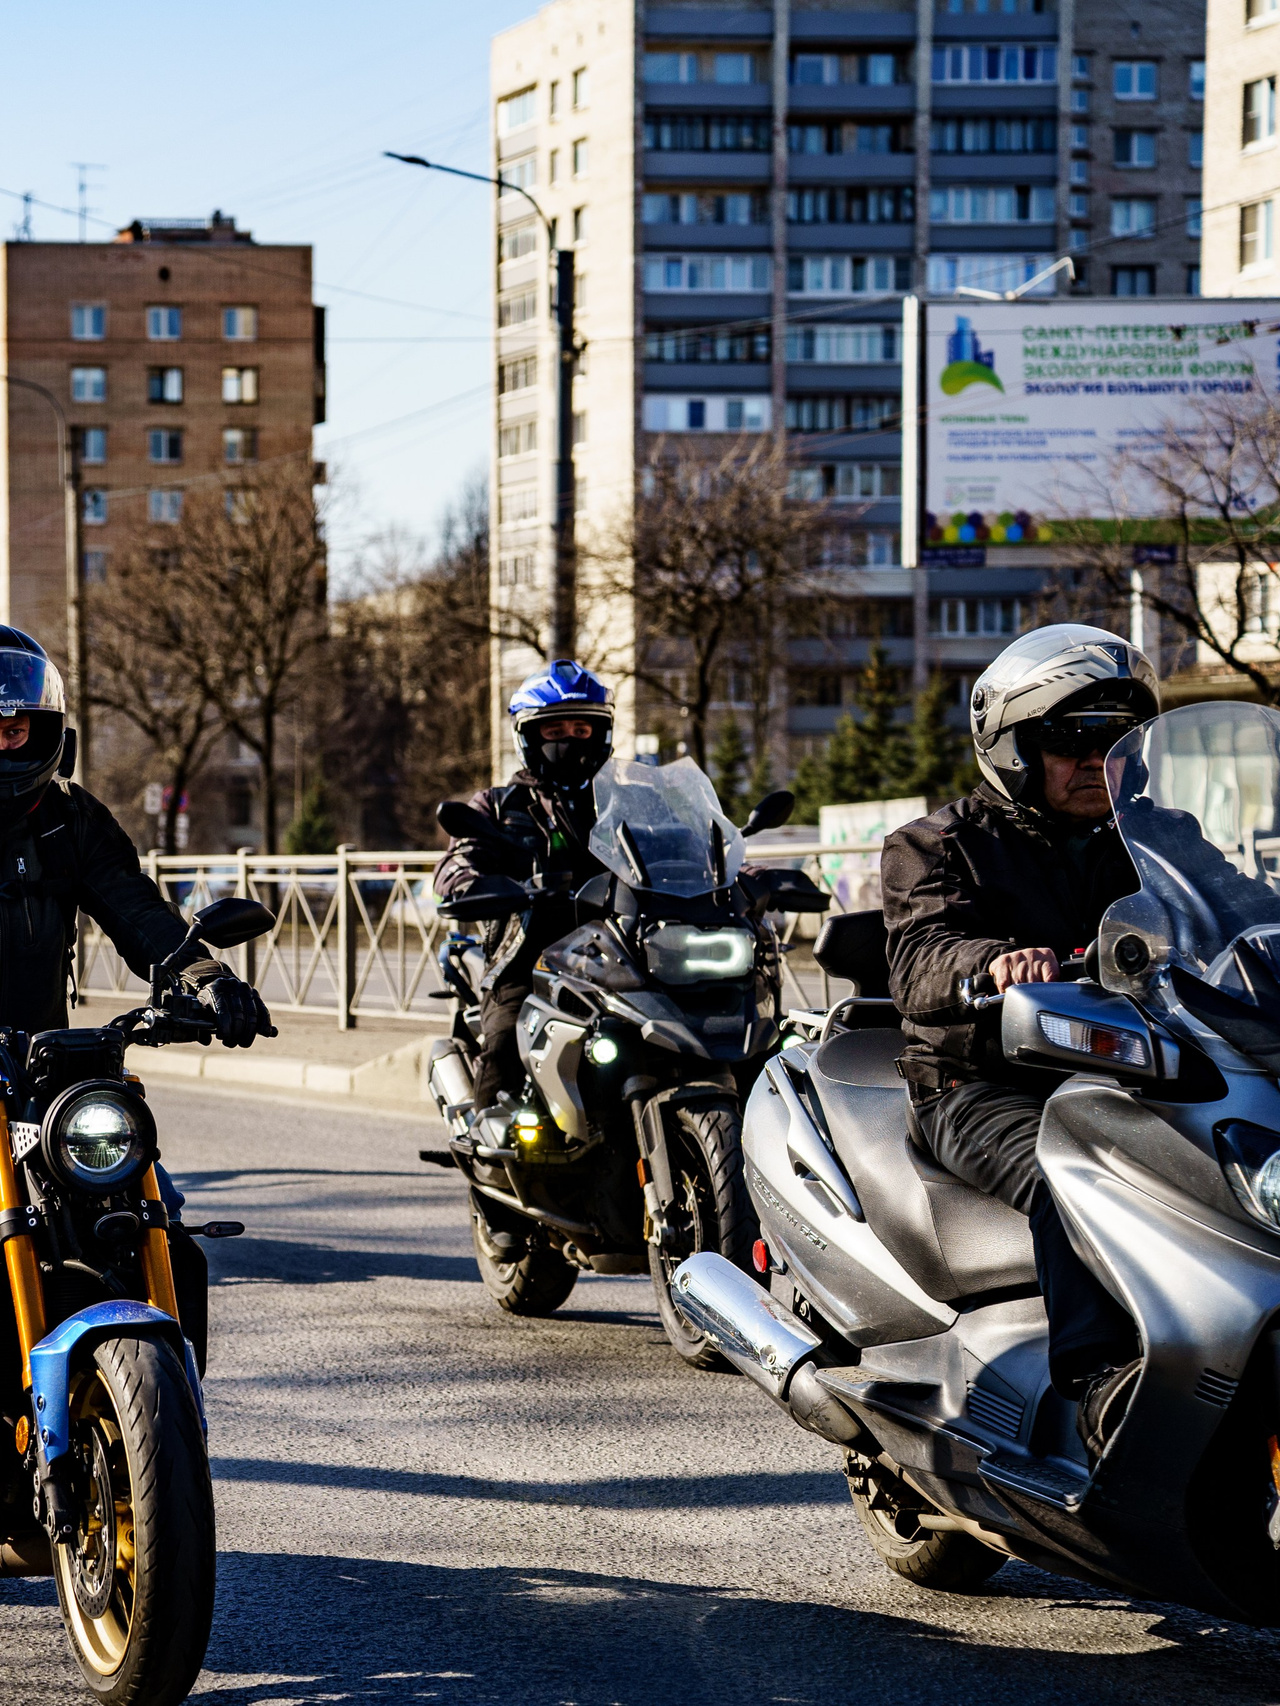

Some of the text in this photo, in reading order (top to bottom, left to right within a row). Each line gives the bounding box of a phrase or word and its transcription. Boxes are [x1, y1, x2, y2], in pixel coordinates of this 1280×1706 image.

[1022, 323, 1257, 341] САНКТ-ПЕТЕРБРГСКИ
[1022, 342, 1200, 360] МЕЖДУНАРОДНЫЙ
[1022, 361, 1255, 378] ЭКОЛОГИЧЕСКИЙ ФОРУМ
[1023, 380, 1254, 395] ЭКОЛОГИЯ БОЛЬШОГО ГОРОДА
